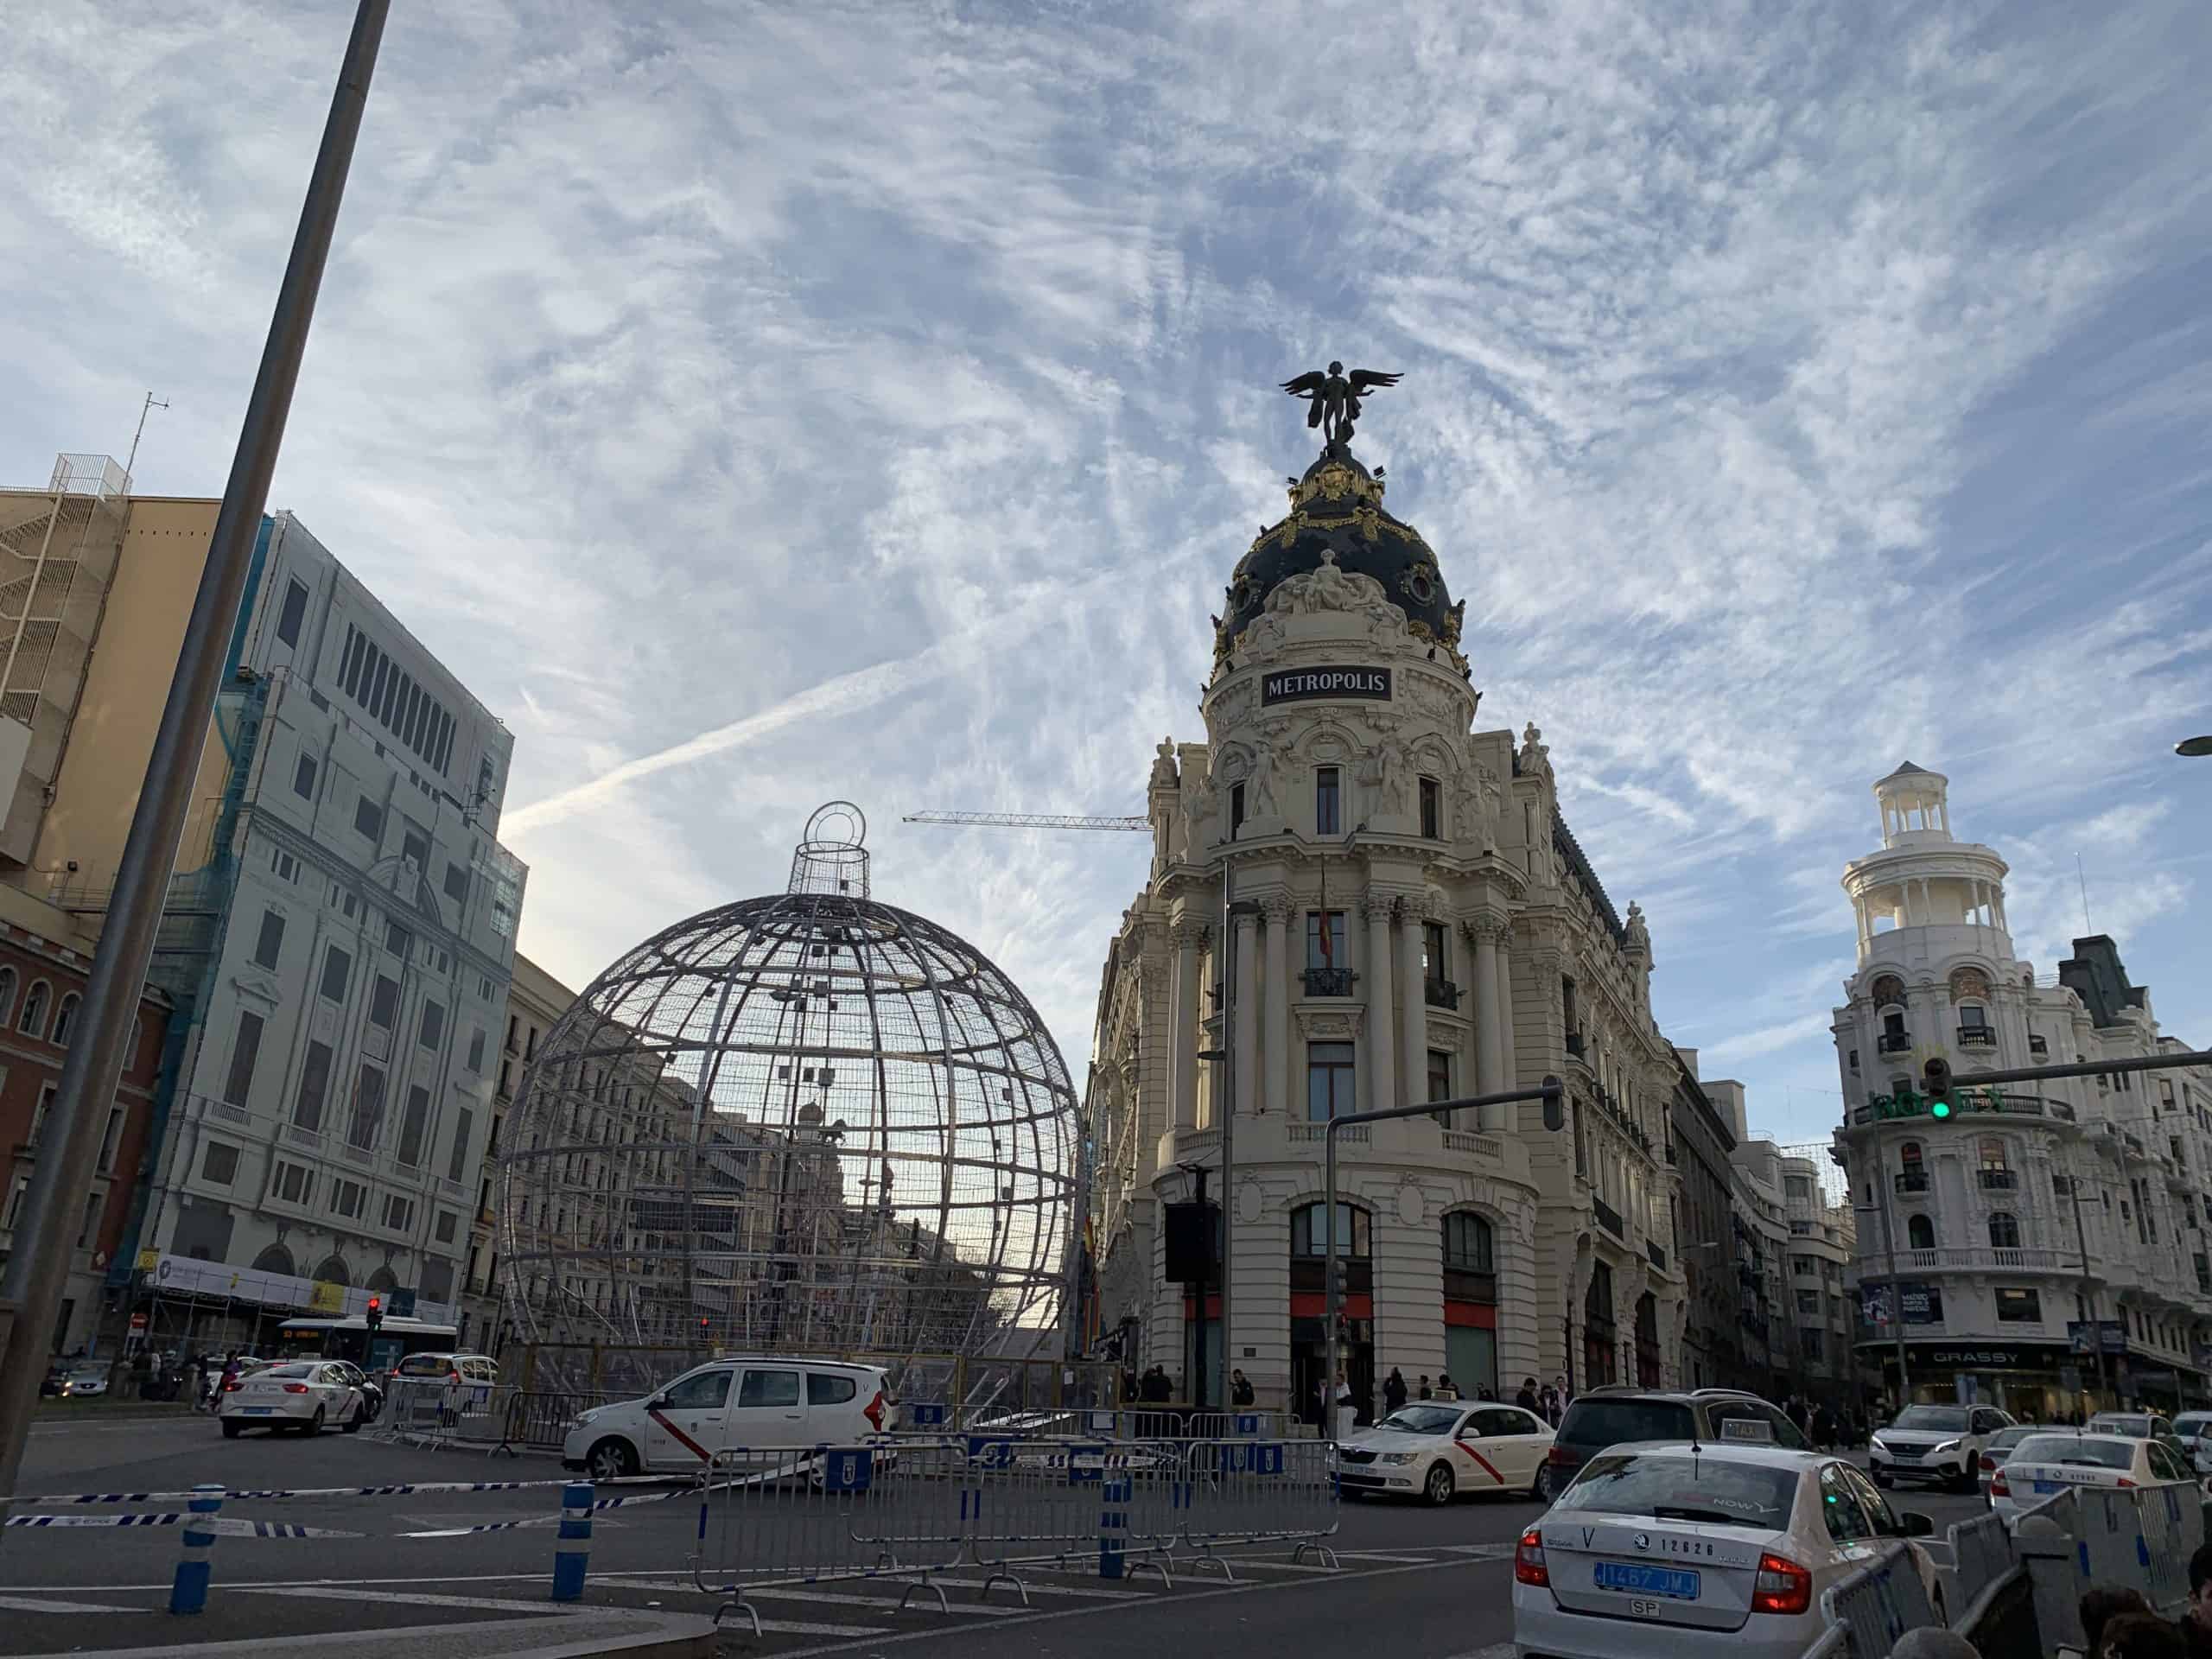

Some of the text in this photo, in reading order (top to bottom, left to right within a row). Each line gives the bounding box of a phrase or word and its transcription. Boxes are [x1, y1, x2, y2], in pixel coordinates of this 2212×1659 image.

[1268, 672, 1385, 697] METROPOLIS
[1933, 1352, 2018, 1363] GRASSY
[1582, 1527, 1595, 1548] V
[1662, 1539, 1713, 1556] 12626
[1608, 1567, 1695, 1594] 1467 JMJ
[1633, 1601, 1656, 1614] SP
